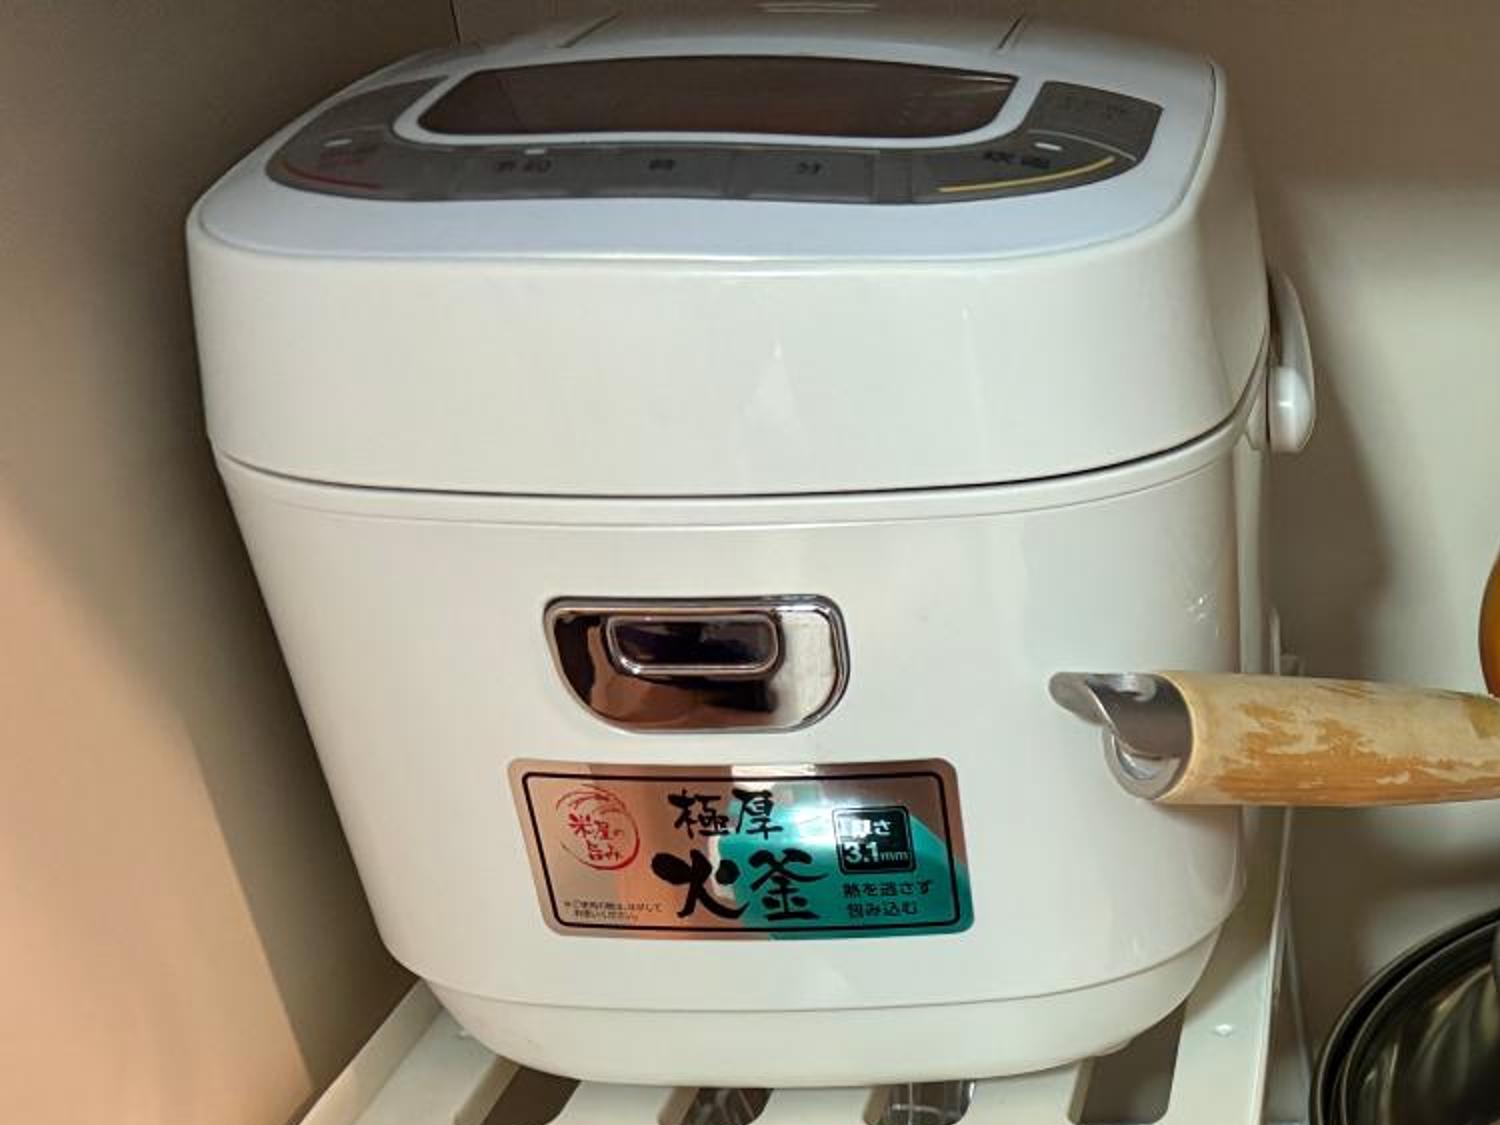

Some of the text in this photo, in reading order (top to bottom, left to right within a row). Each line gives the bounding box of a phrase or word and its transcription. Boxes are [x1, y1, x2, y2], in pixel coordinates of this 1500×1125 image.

[668, 789, 783, 839] 極厚
[843, 840, 909, 864] 3.1mm
[652, 849, 829, 921] 火釜
